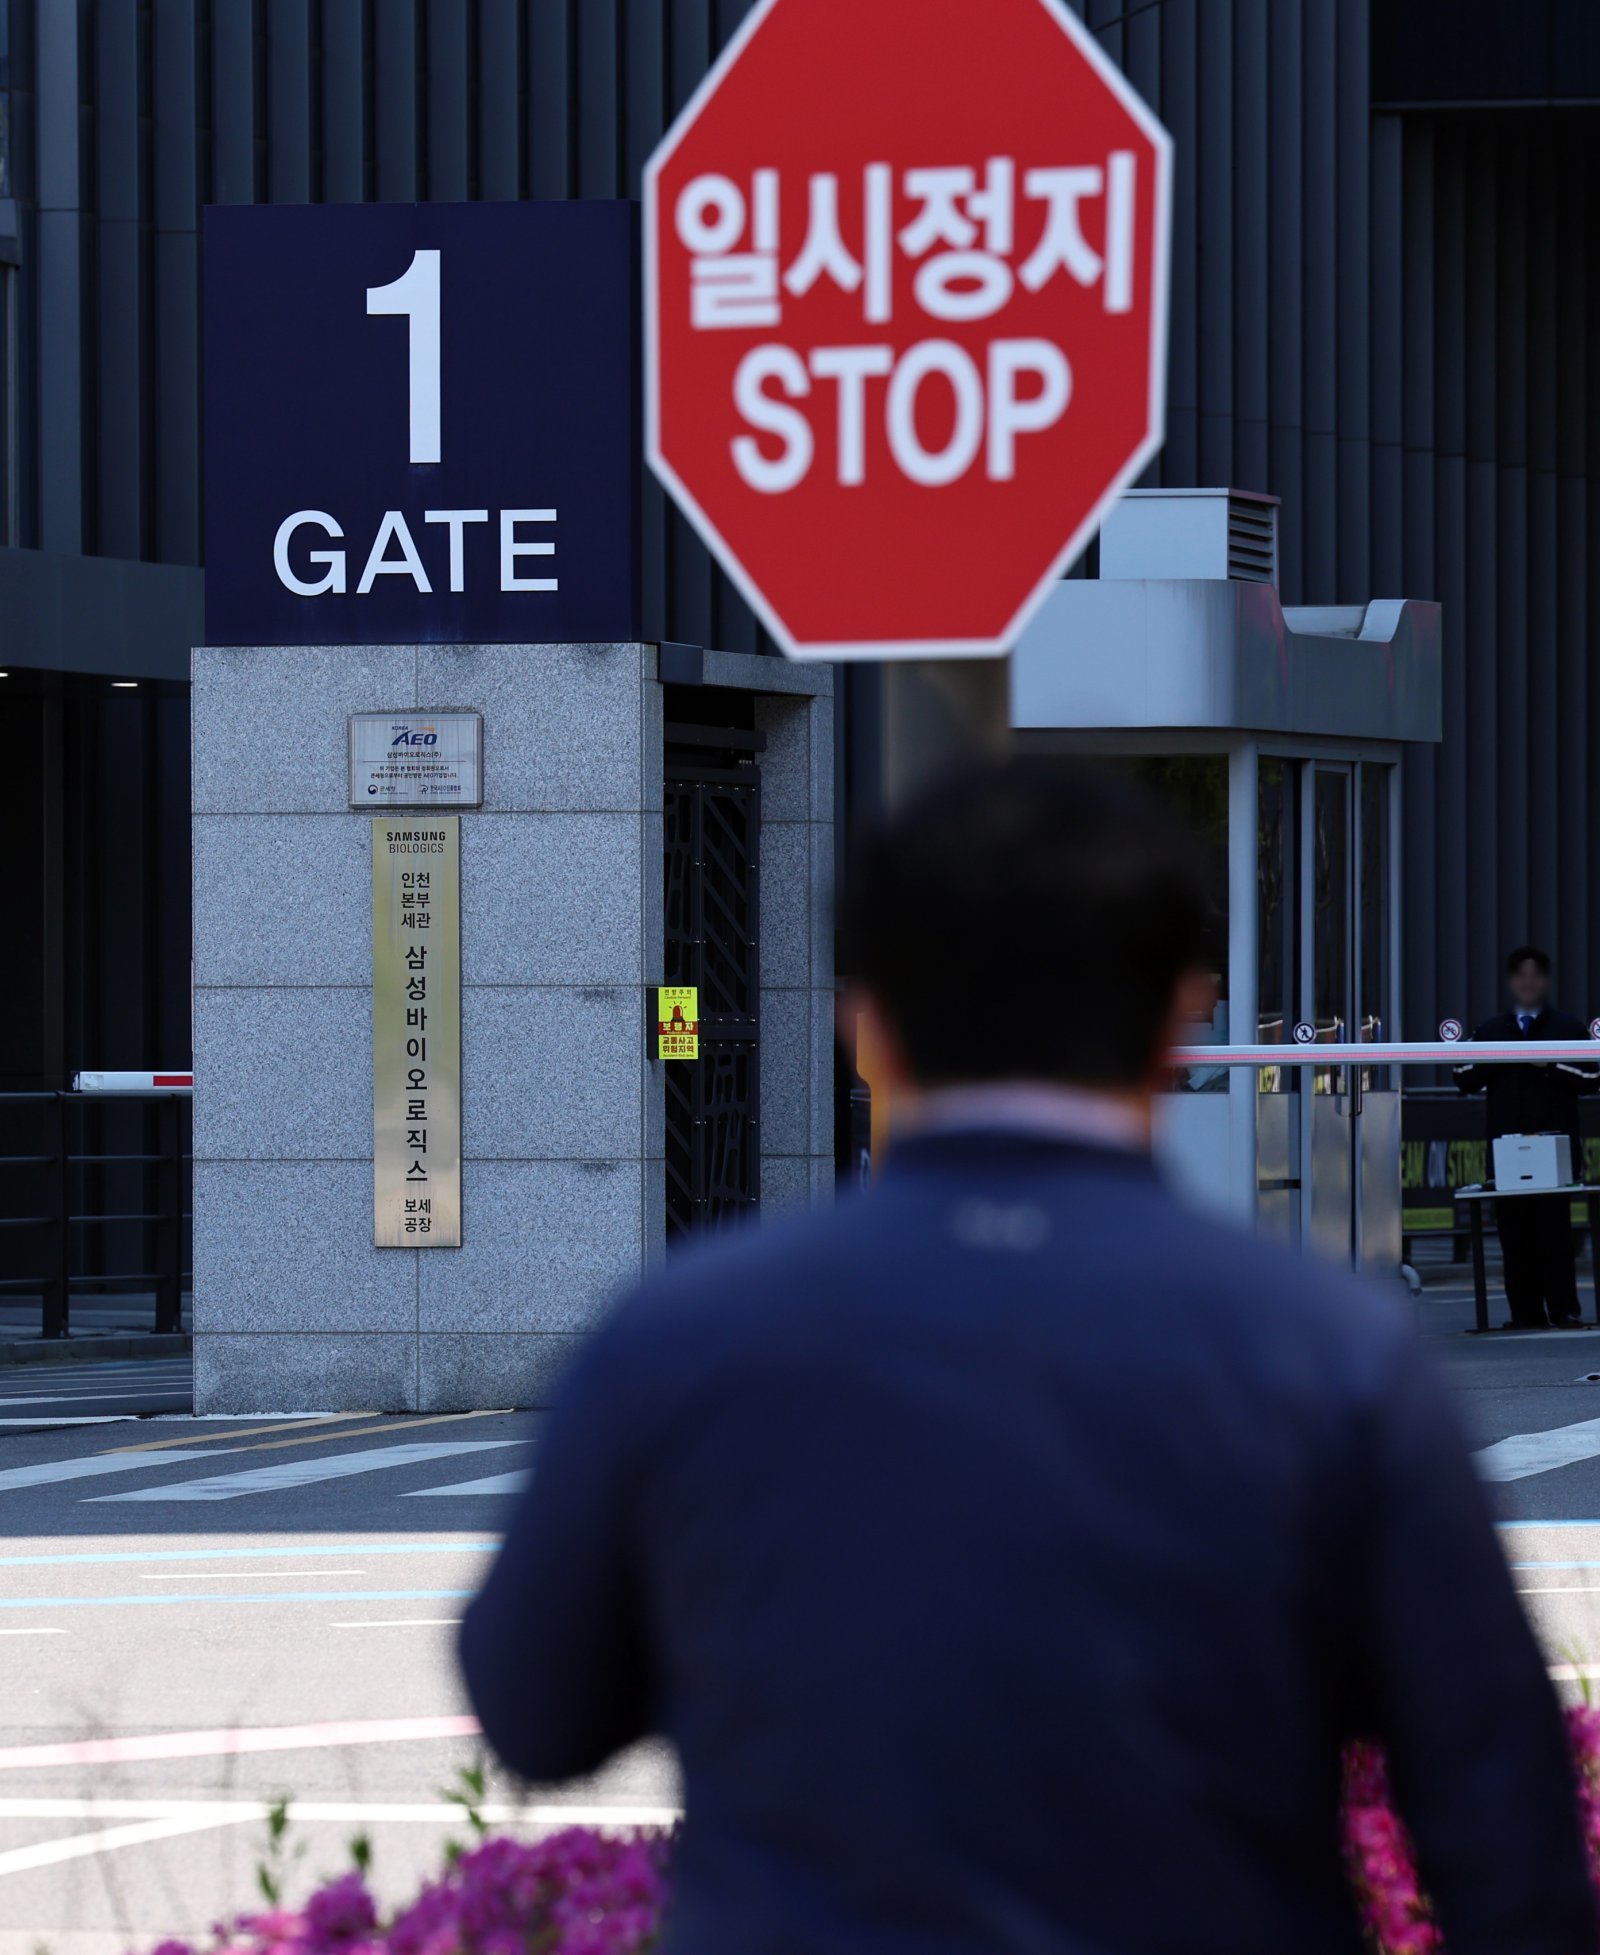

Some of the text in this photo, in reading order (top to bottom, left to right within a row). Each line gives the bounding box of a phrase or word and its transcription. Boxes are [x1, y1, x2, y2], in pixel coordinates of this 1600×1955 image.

[674, 150, 1136, 330] 일시정지
[366, 249, 441, 463] 1
[730, 337, 1074, 494] STOP
[273, 509, 558, 596] GATE
[391, 730, 438, 745] AEO
[386, 832, 446, 842] SAMSUNG
[389, 844, 444, 854] BIOLOGICS
[402, 872, 430, 889] 인천
[401, 892, 430, 908] 본부
[401, 912, 431, 929] 세관
[405, 946, 428, 1182] 삼성바이오로직스
[404, 1199, 431, 1214] 보세
[404, 1218, 432, 1232] 공장
